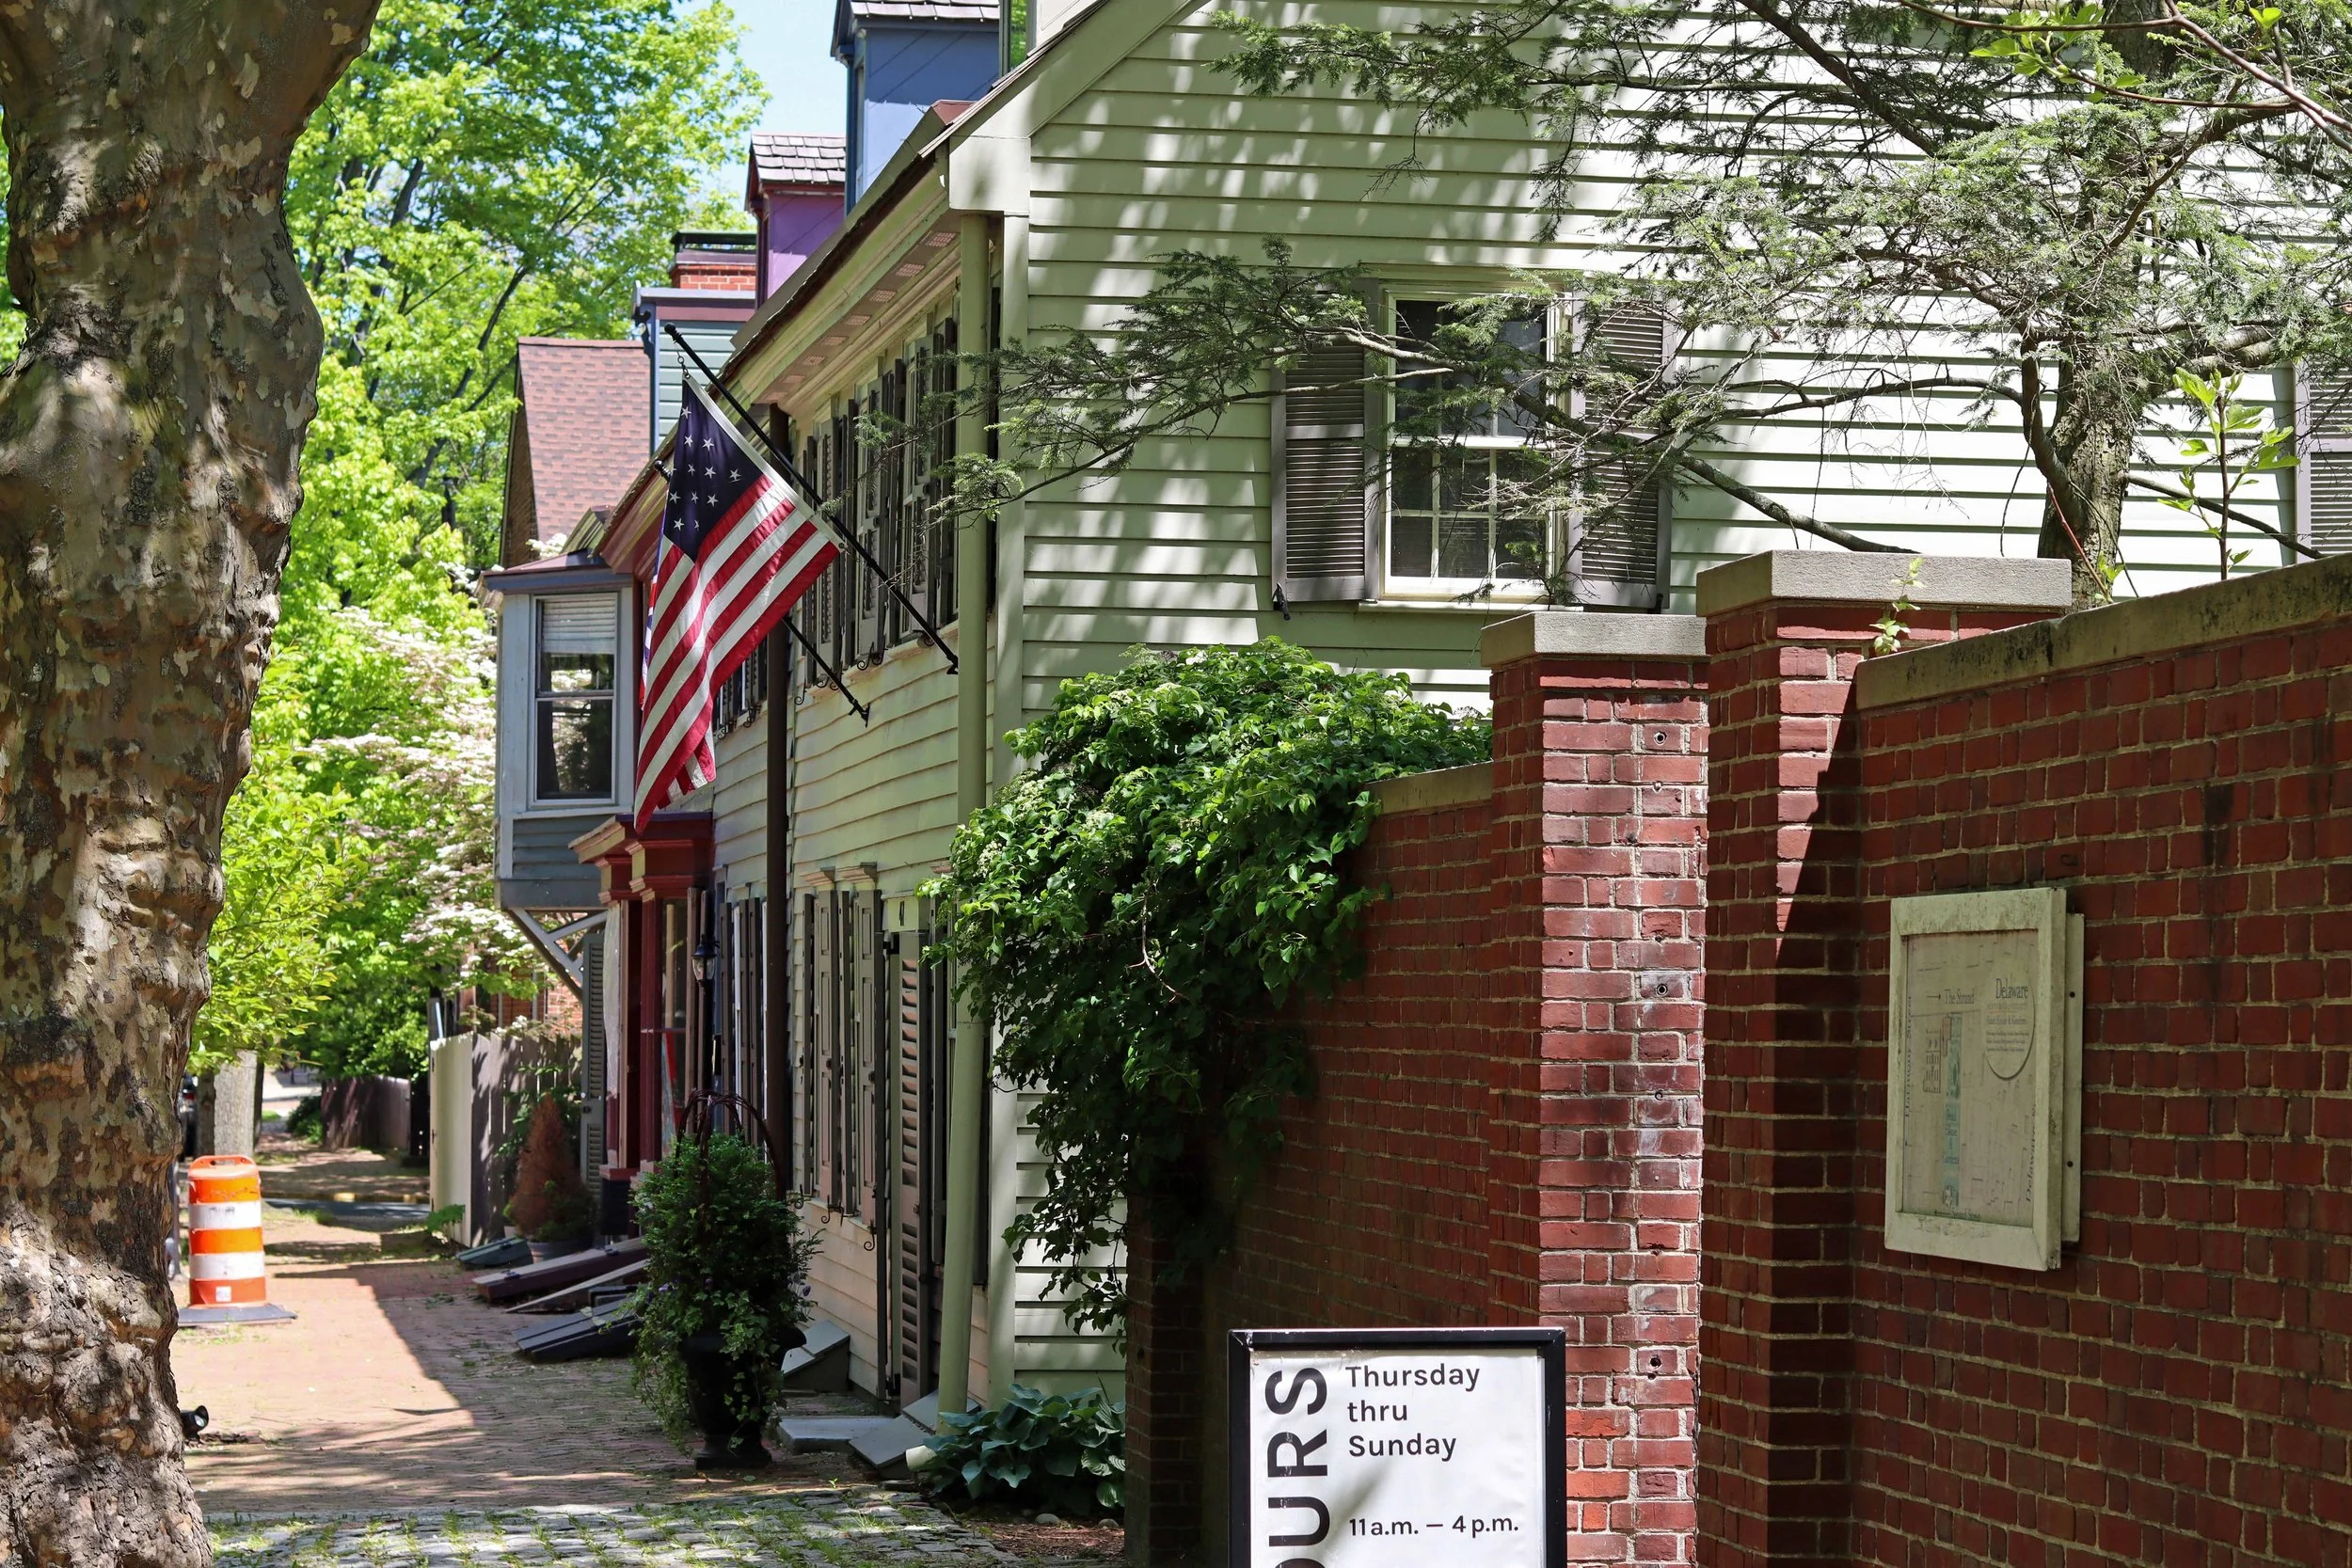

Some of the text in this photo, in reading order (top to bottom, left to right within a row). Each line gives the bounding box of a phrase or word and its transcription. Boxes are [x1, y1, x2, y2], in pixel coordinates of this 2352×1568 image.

[1995, 977, 2028, 999] Delaware
[1344, 1363, 1480, 1392] Thursday
[1346, 1400, 1407, 1423] thru
[1349, 1433, 1456, 1463] Sunday
[1264, 1367, 1330, 1568] URS
